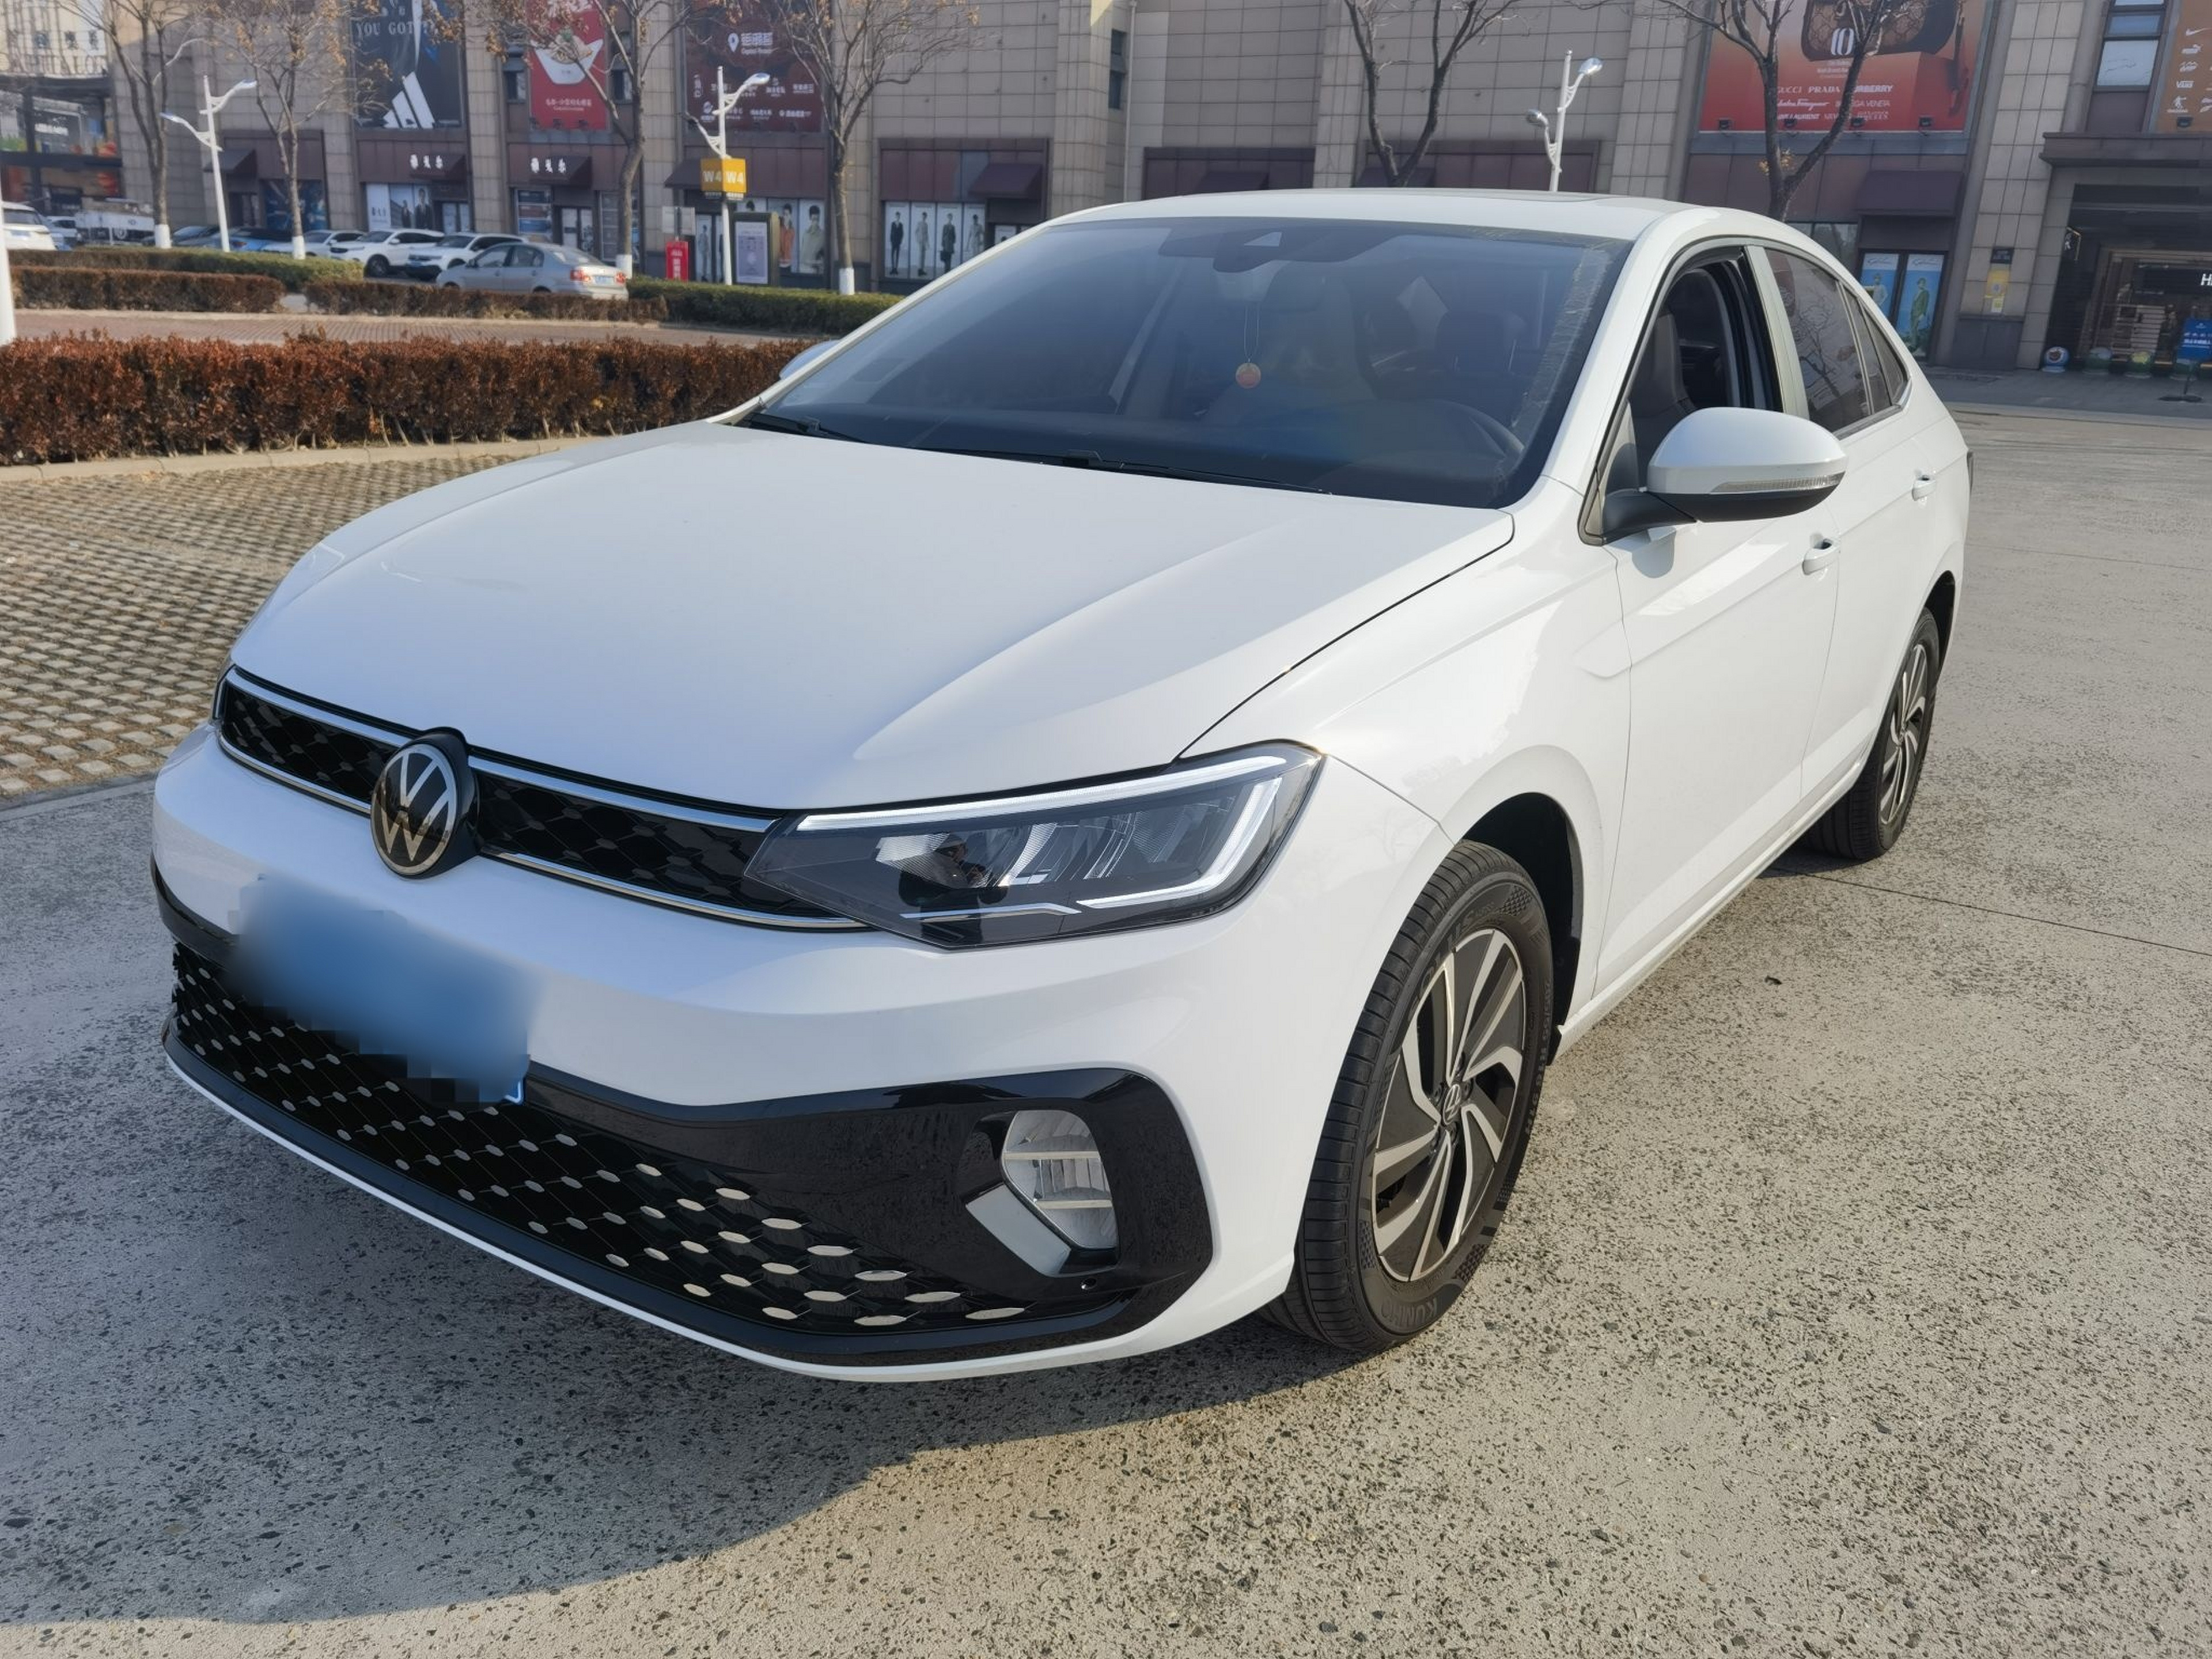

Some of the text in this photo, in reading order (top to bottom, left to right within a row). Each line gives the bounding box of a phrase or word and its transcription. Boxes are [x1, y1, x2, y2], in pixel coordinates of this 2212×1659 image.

[356, 22, 381, 36] YOU
[703, 171, 722, 182] W4
[726, 172, 744, 183] W4
